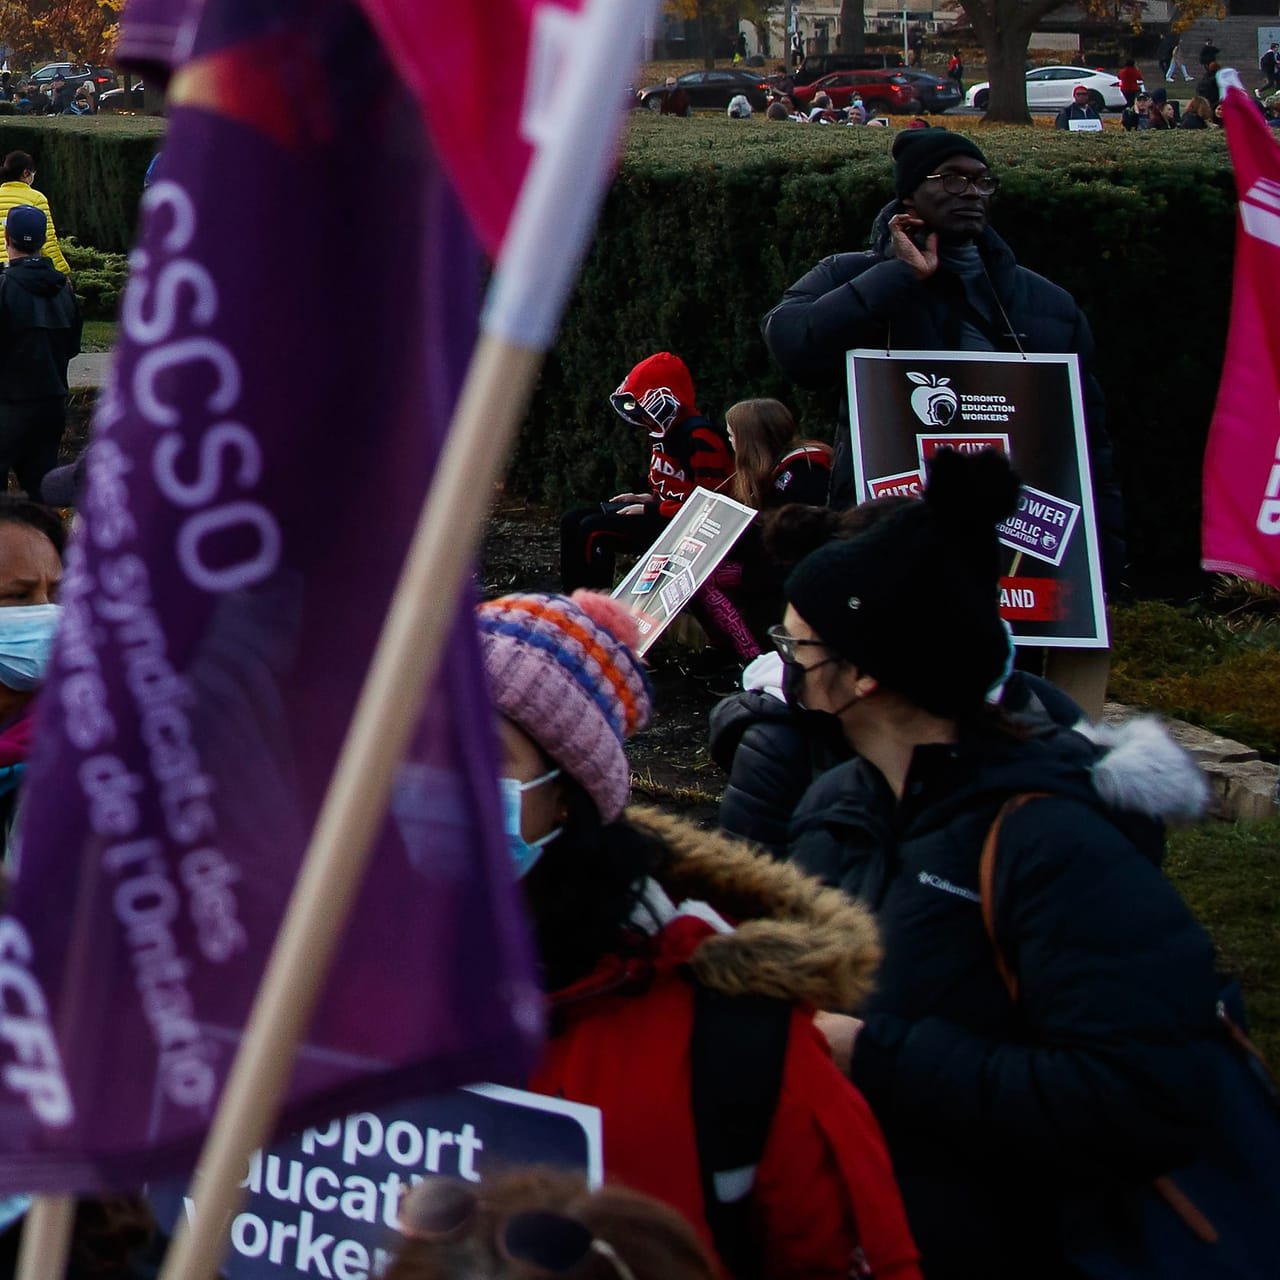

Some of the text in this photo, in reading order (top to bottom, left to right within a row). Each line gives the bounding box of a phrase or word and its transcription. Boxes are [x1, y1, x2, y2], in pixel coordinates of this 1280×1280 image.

[960, 394, 1006, 403] TORONTO
[960, 404, 1016, 412] EDUCATION
[961, 413, 1009, 422] WORKERS
